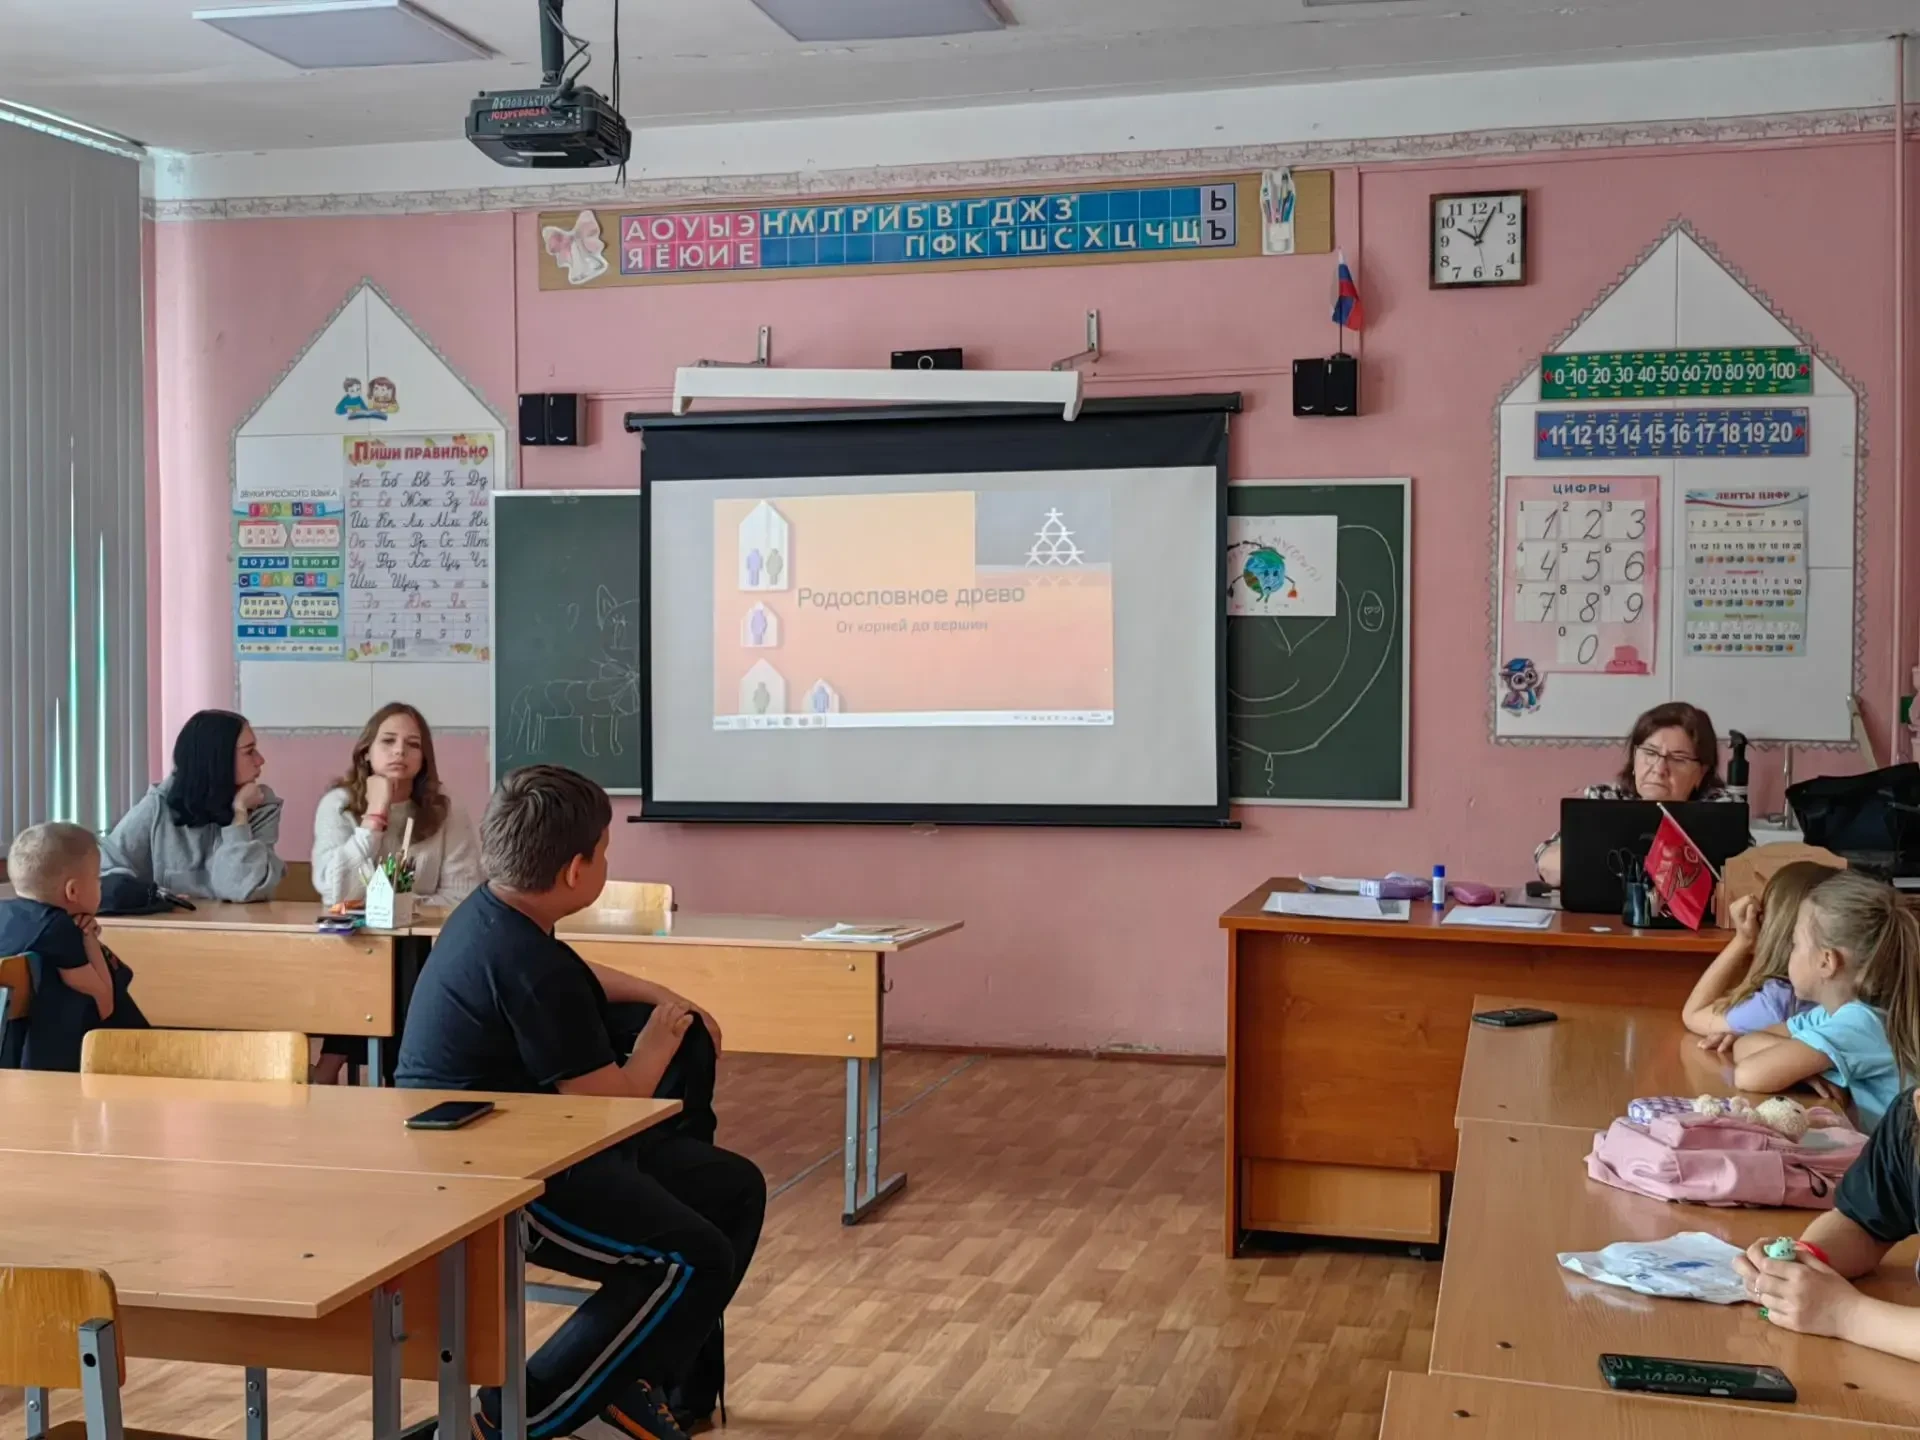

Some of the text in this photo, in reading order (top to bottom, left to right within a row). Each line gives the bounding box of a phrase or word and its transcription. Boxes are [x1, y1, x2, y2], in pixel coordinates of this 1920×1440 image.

[1449, 203, 1463, 216] 11
[1471, 201, 1488, 215] 12
[1497, 201, 1504, 214] 1
[1440, 216, 1456, 229] 10
[1506, 213, 1517, 226] 2
[1440, 235, 1450, 248] 9
[1506, 232, 1517, 245] 3
[1440, 255, 1450, 268] 8
[1506, 252, 1517, 265] 4
[1451, 266, 1462, 279] 7
[1473, 266, 1483, 279] 6
[1494, 264, 1504, 278] 5
[1554, 361, 1796, 386] 0 10 20 30 40 50 60 70 80 90 100
[1549, 421, 1794, 446] 11 12 13 14 15 16 17 18 19 20
[404, 445, 489, 461] ПРАВИЛЬНО
[1552, 483, 1612, 496] ЦИФРЫ
[1715, 491, 1791, 500] ЛЕНТЫ ЦИФР
[1518, 501, 1525, 512] 1
[1561, 501, 1569, 513] 2
[1606, 501, 1613, 512] 3
[1541, 508, 1559, 541] 1
[1583, 508, 1603, 540] 2
[1626, 508, 1646, 540] 3
[1516, 543, 1525, 553] 4
[1560, 543, 1568, 553] 5
[1604, 543, 1612, 553] 6
[1540, 549, 1557, 582] 4
[1582, 550, 1601, 582] 5
[1624, 550, 1645, 582] 6
[1516, 584, 1523, 594] 7
[1559, 584, 1568, 595] 8
[1603, 584, 1611, 595] 9
[797, 585, 1026, 611] Родословное древо
[1538, 592, 1557, 623] 7
[1579, 592, 1600, 623] 8
[1623, 592, 1644, 624] 9
[836, 617, 989, 637] От корней до вершин
[1557, 625, 1566, 637] 0
[1577, 633, 1599, 665] 0
